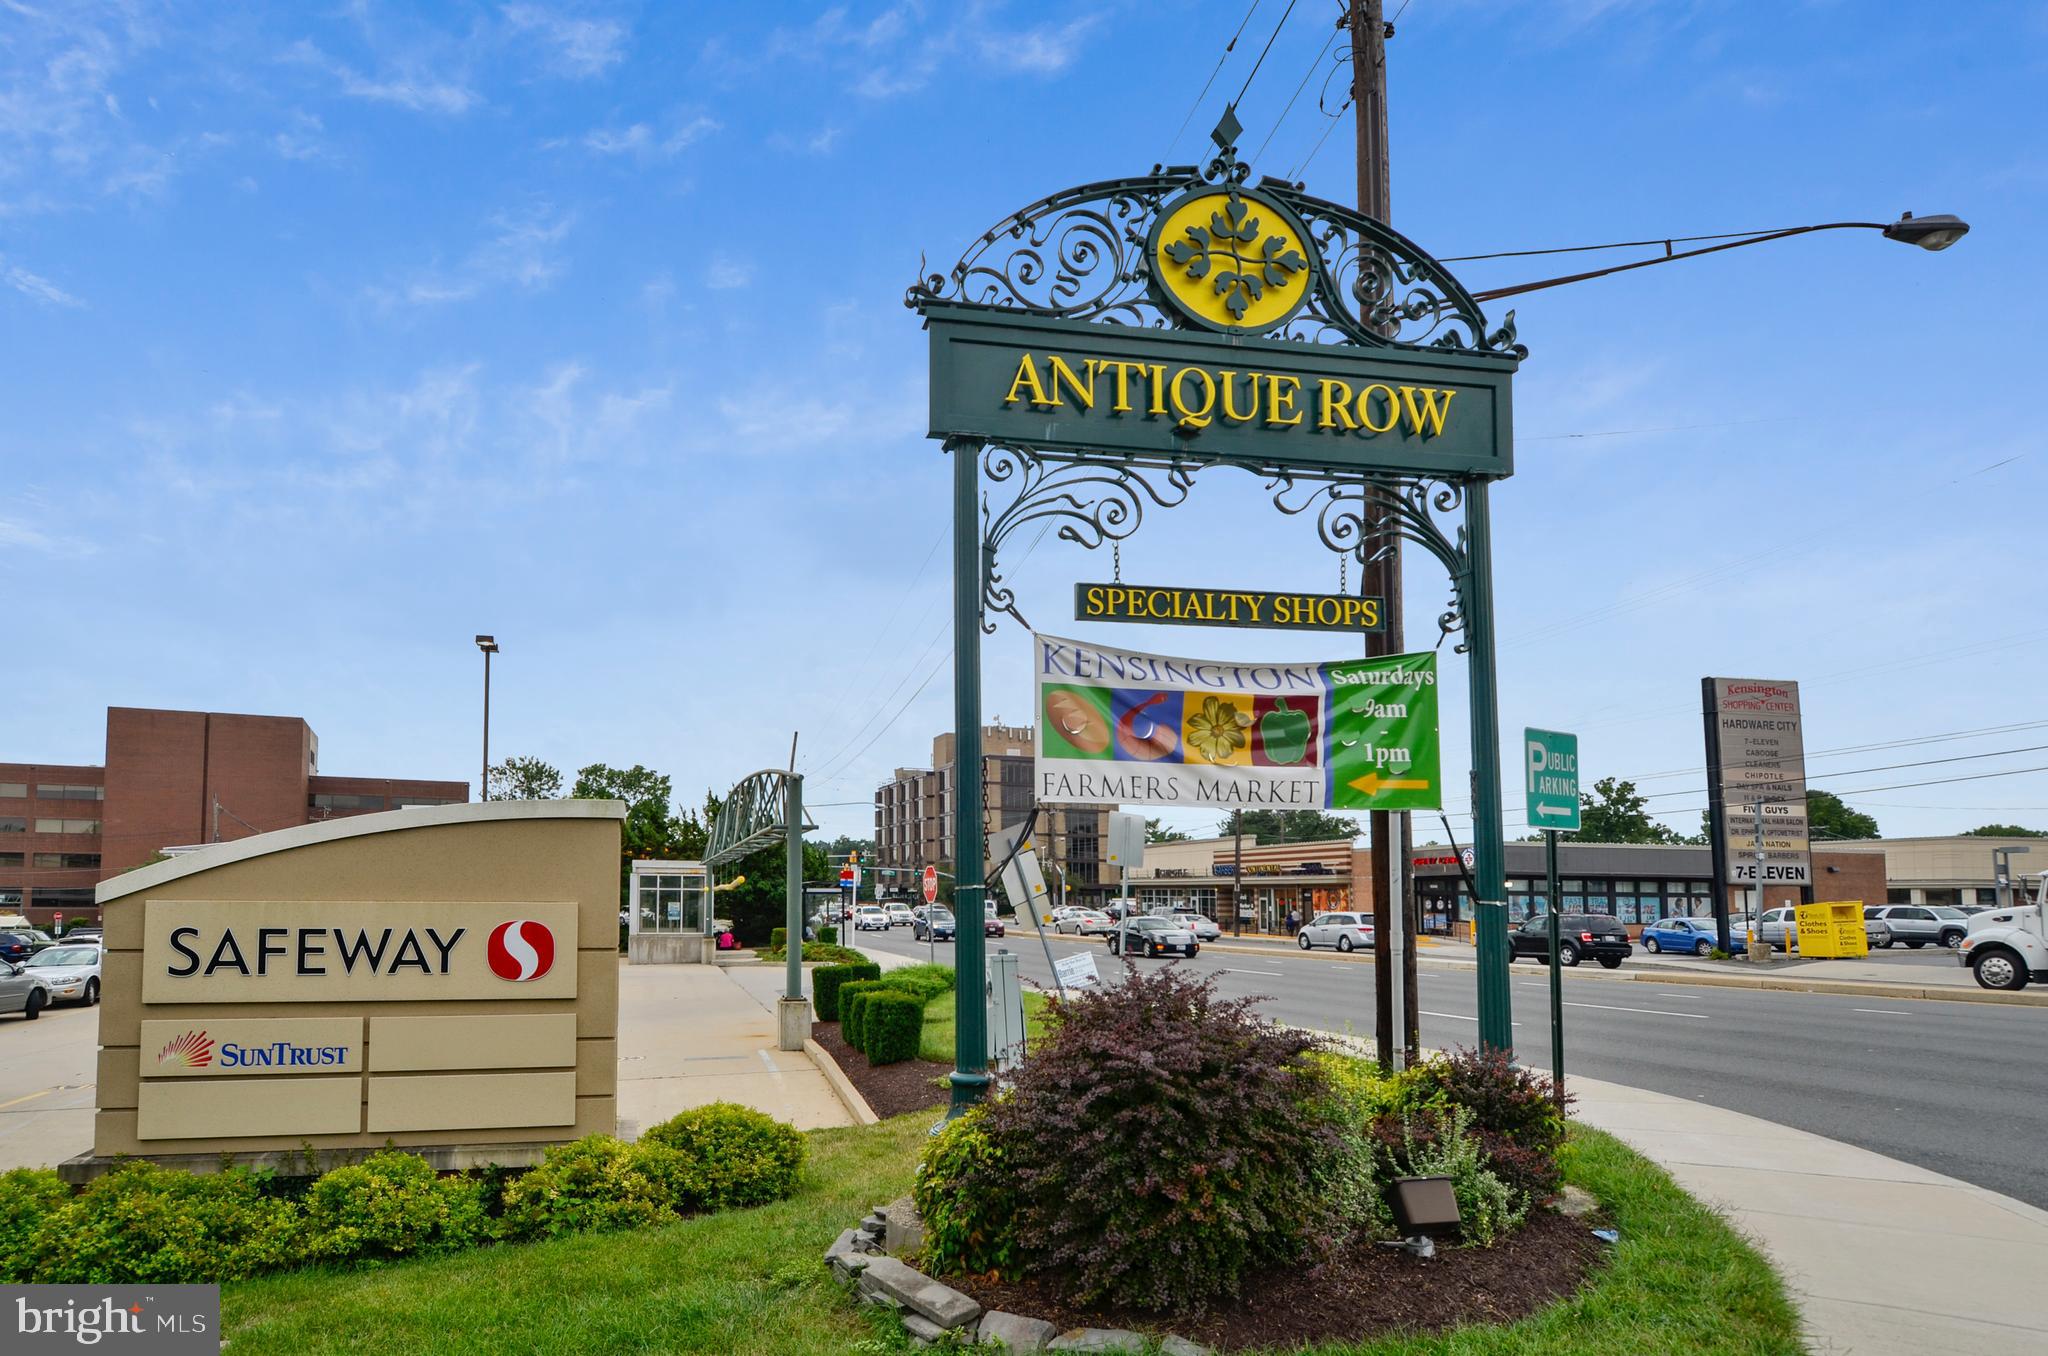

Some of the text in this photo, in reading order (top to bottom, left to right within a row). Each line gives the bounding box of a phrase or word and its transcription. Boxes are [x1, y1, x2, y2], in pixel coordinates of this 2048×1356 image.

[1004, 353, 1457, 437] ANTIQUE ROW
[1086, 587, 1378, 627] SPECIALTY SHOPS
[1041, 643, 1319, 690] KENSINGTON
[1331, 665, 1435, 691] Saturdays
[1727, 682, 1789, 699] Kensington
[1363, 698, 1408, 718] 9am
[1722, 700, 1794, 712] SHOPPING CENTER
[1722, 719, 1798, 732] HARDWARE CITY
[1744, 738, 1779, 746] 7-ELEVEN
[1364, 743, 1411, 769] 1pm
[1744, 772, 1785, 780] CHIPOTLE
[1041, 772, 1320, 804] FARMERS MARKET
[1772, 784, 1792, 792] NAILS
[1743, 805, 1789, 815] FIV GUYS
[1729, 817, 1772, 825] INTERNATNAL
[924, 877, 937, 891] STOP
[166, 925, 467, 978] SAFEWAY
